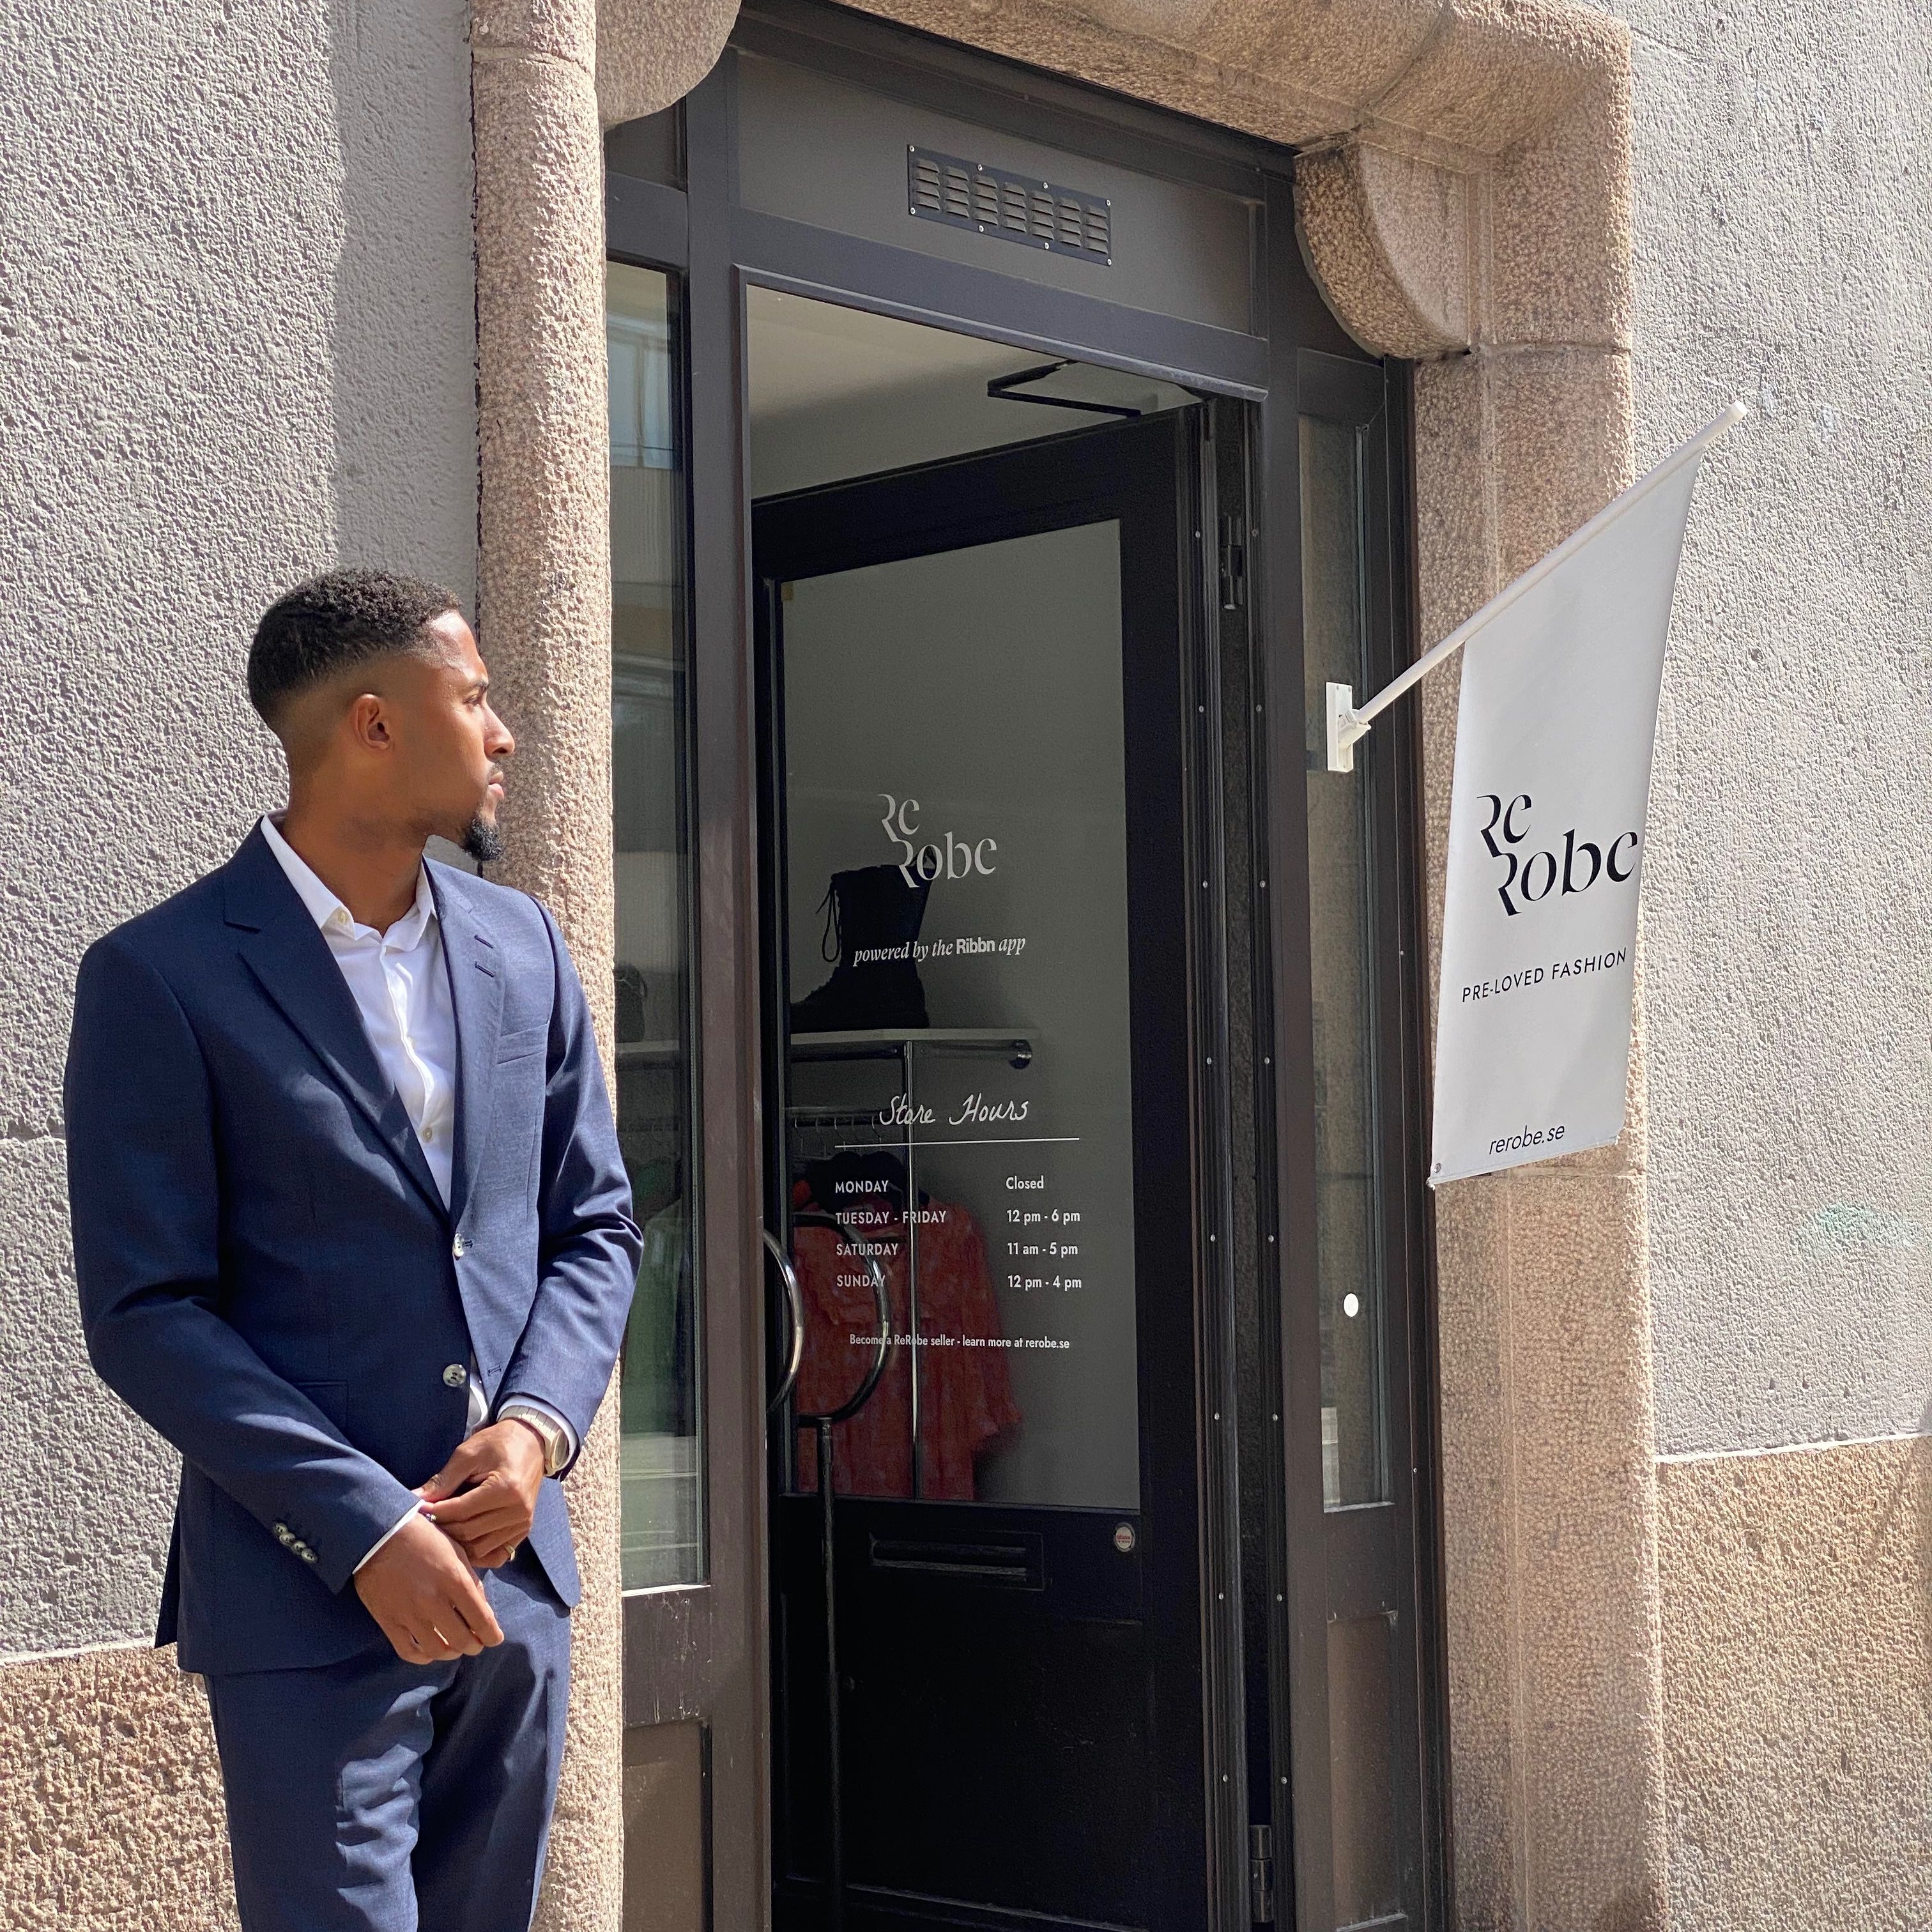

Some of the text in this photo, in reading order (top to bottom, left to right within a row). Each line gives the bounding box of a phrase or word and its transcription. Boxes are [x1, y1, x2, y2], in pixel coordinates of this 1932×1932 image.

[896, 831, 997, 888] Robe
[1494, 829, 1638, 916] Robe
[853, 936, 1025, 967] powered by the Ribbn app
[1462, 948, 1626, 1002] PRE-LOVED FASHION
[880, 1093, 1029, 1126] Store Hours
[1489, 1125, 1565, 1154] rerobe.se
[836, 1181, 889, 1193] MONDAY
[1006, 1176, 1044, 1190] Closed
[836, 1212, 890, 1225] TUESDAY
[903, 1211, 946, 1223] FRIDAY
[1007, 1209, 1020, 1222] 12
[1024, 1213, 1041, 1225] pm
[1052, 1210, 1059, 1222] 6
[1062, 1213, 1080, 1225] pm
[836, 1243, 898, 1255] SATURDAY
[1008, 1242, 1019, 1255] 11
[1023, 1246, 1039, 1255] am
[1050, 1243, 1057, 1255] 5
[1061, 1246, 1078, 1258] pm
[836, 1275, 885, 1287] SUNDAY
[1008, 1275, 1021, 1287] 12
[1025, 1278, 1041, 1291] pm
[1053, 1275, 1061, 1288] 4
[1064, 1279, 1082, 1292] pm
[850, 1334, 884, 1346] Become
[894, 1335, 928, 1346] ReRobe
[931, 1335, 954, 1346] seller
[963, 1335, 985, 1347] learn
[988, 1338, 1011, 1347] more
[1015, 1337, 1023, 1347] at
[1025, 1337, 1070, 1349] rerobe.se
